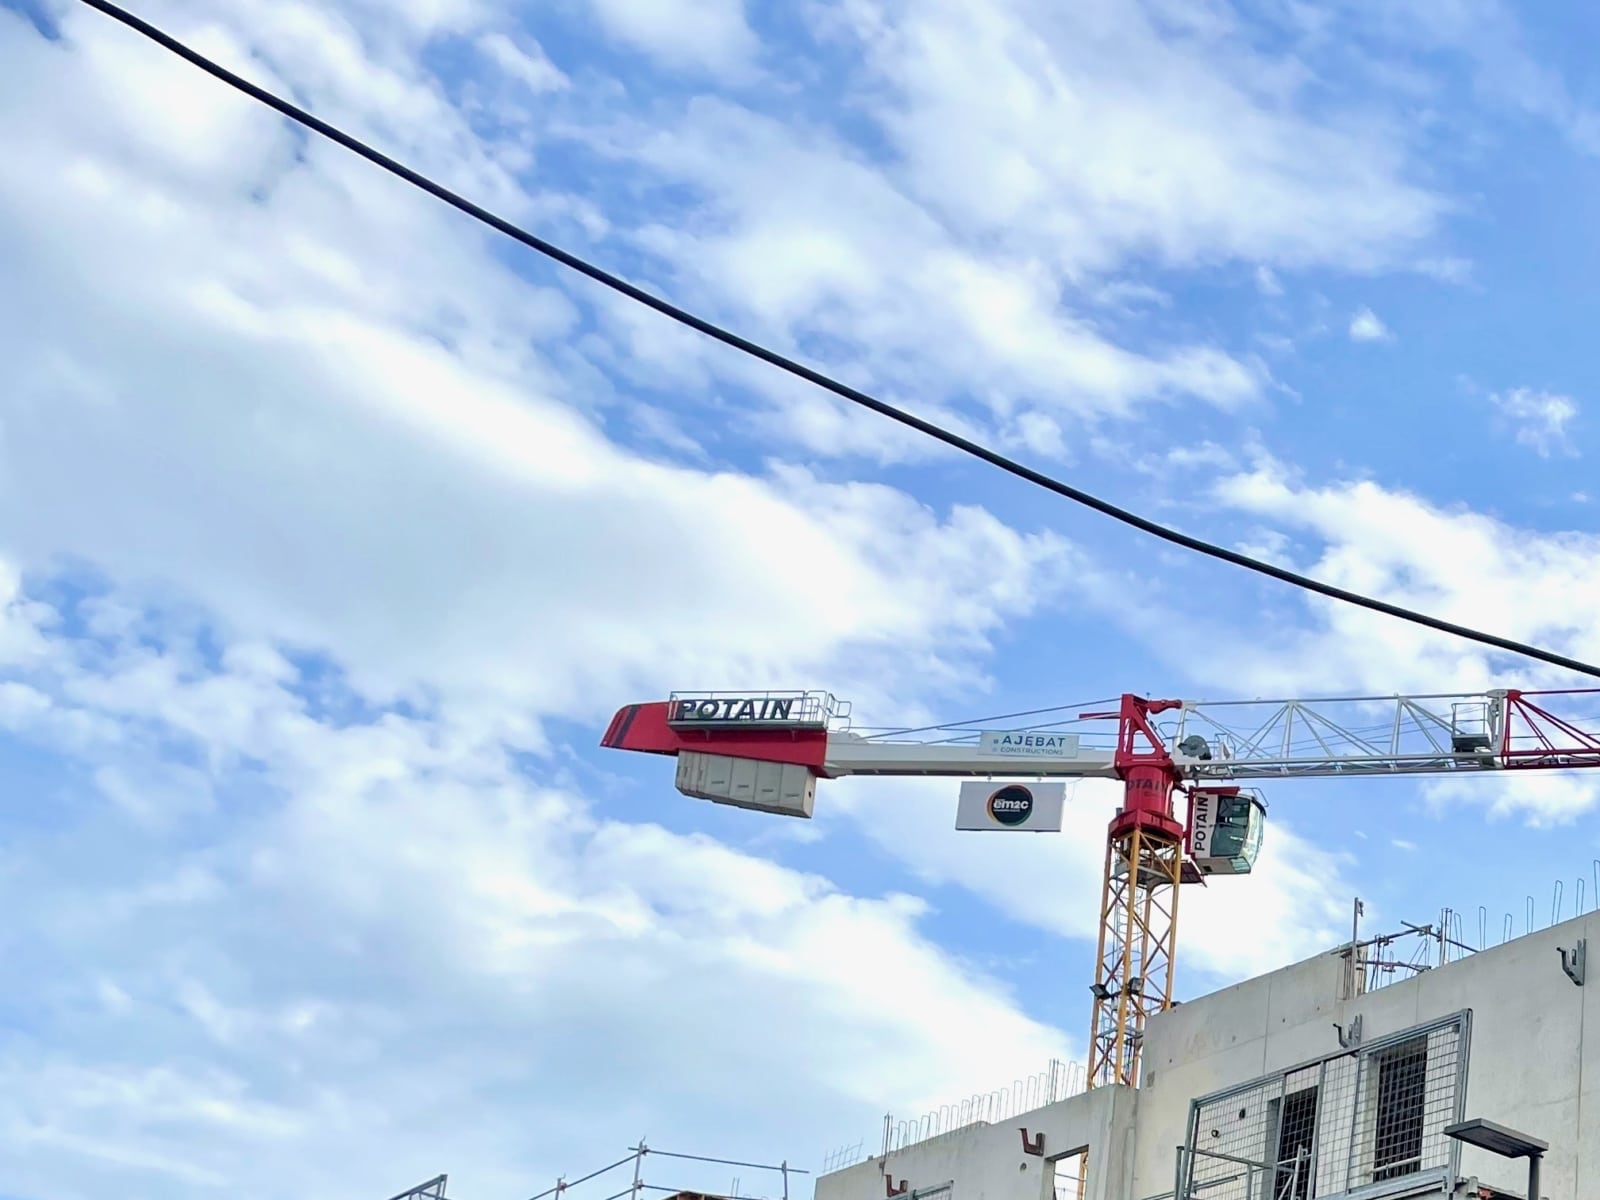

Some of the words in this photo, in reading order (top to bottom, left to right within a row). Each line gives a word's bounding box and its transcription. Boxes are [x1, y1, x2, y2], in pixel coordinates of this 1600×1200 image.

[675, 699, 794, 721] POTAIN
[1001, 735, 1066, 748] AJEBAT
[1000, 746, 1064, 756] CONSTRUCTIONS
[993, 799, 1029, 810] em2c
[1195, 797, 1208, 851] POTAIN
